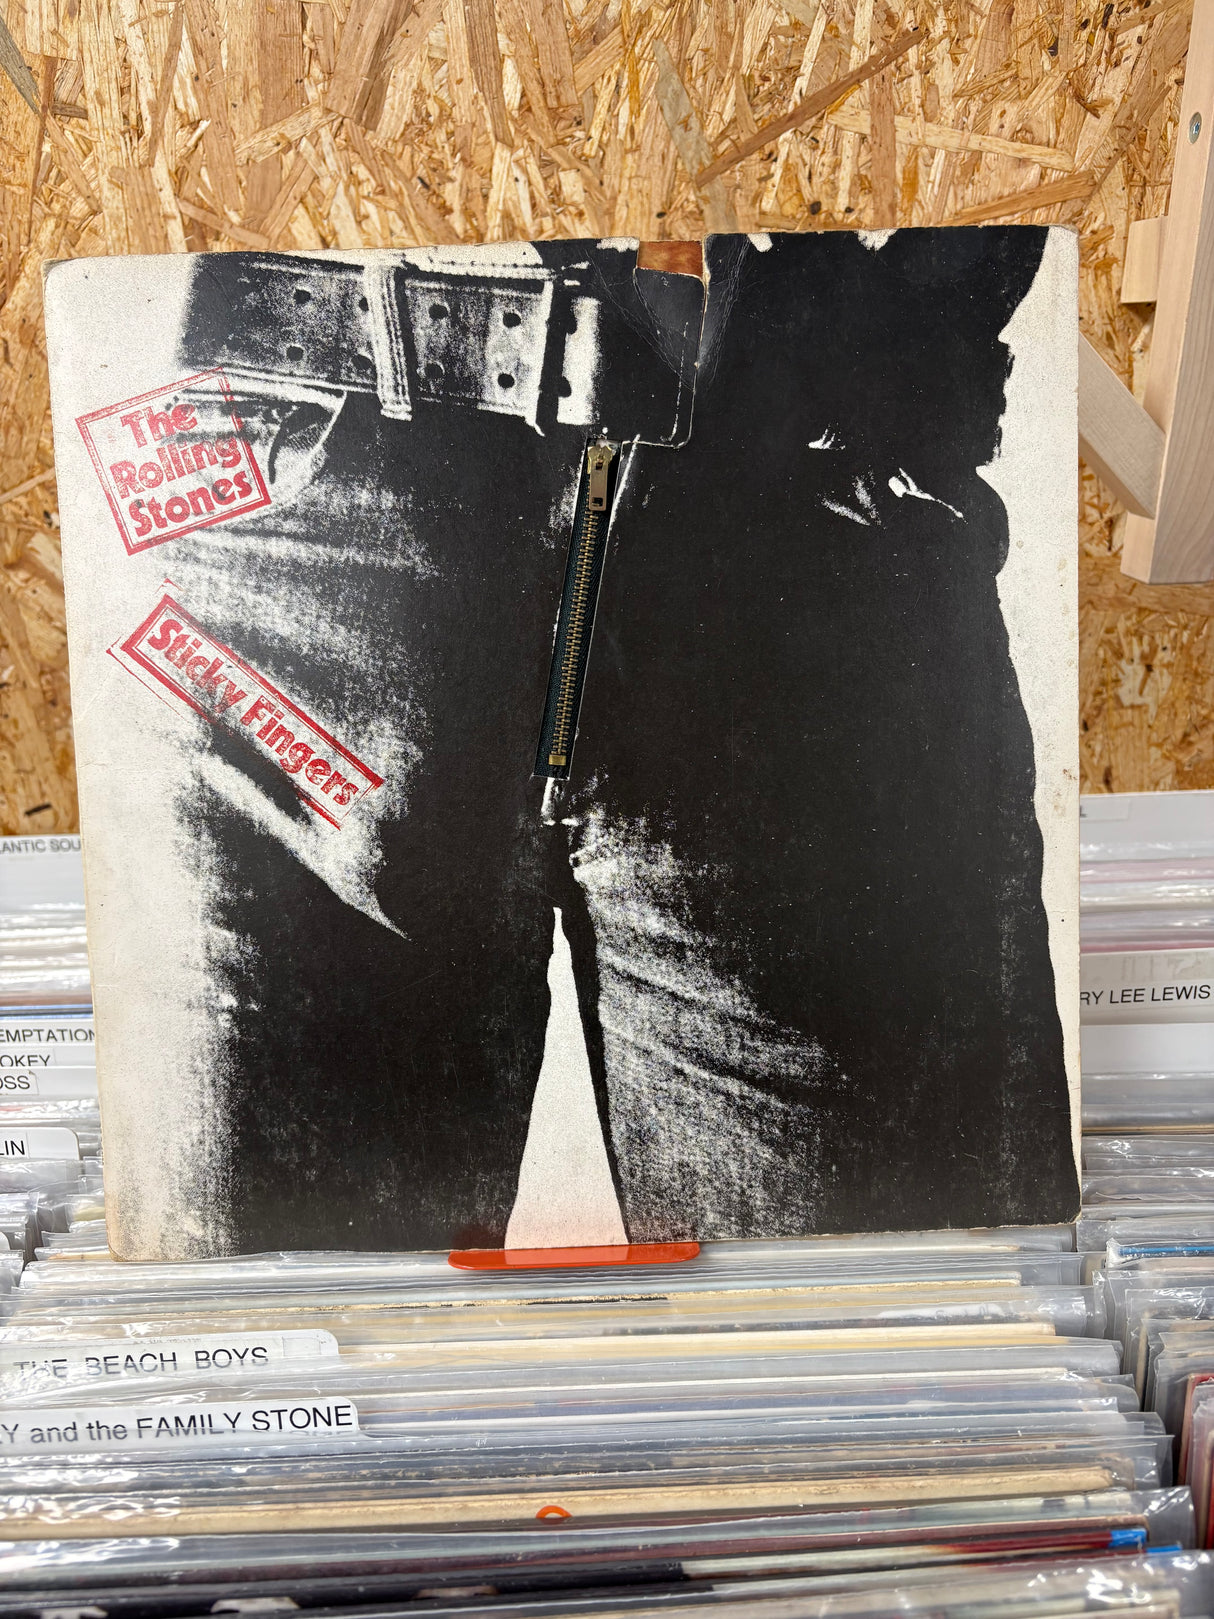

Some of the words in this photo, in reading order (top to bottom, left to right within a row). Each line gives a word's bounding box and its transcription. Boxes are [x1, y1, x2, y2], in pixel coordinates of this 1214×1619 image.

[120, 403, 198, 448] The
[109, 436, 242, 500] Rolling
[128, 470, 253, 537] Stones
[147, 619, 248, 713] Sticky
[240, 695, 359, 806] Fingers
[0, 838, 46, 854] ANTIC
[1109, 988, 1146, 1004] LEE
[1151, 984, 1211, 1002] LEWIS
[0, 1075, 30, 1090] SS
[85, 1352, 177, 1377] BEACH
[194, 1347, 269, 1370] BOYS
[0, 1423, 19, 1444] Y
[30, 1421, 78, 1443] and
[86, 1420, 128, 1440] the
[137, 1411, 241, 1439] FAMILY
[252, 1405, 353, 1431] STONE
